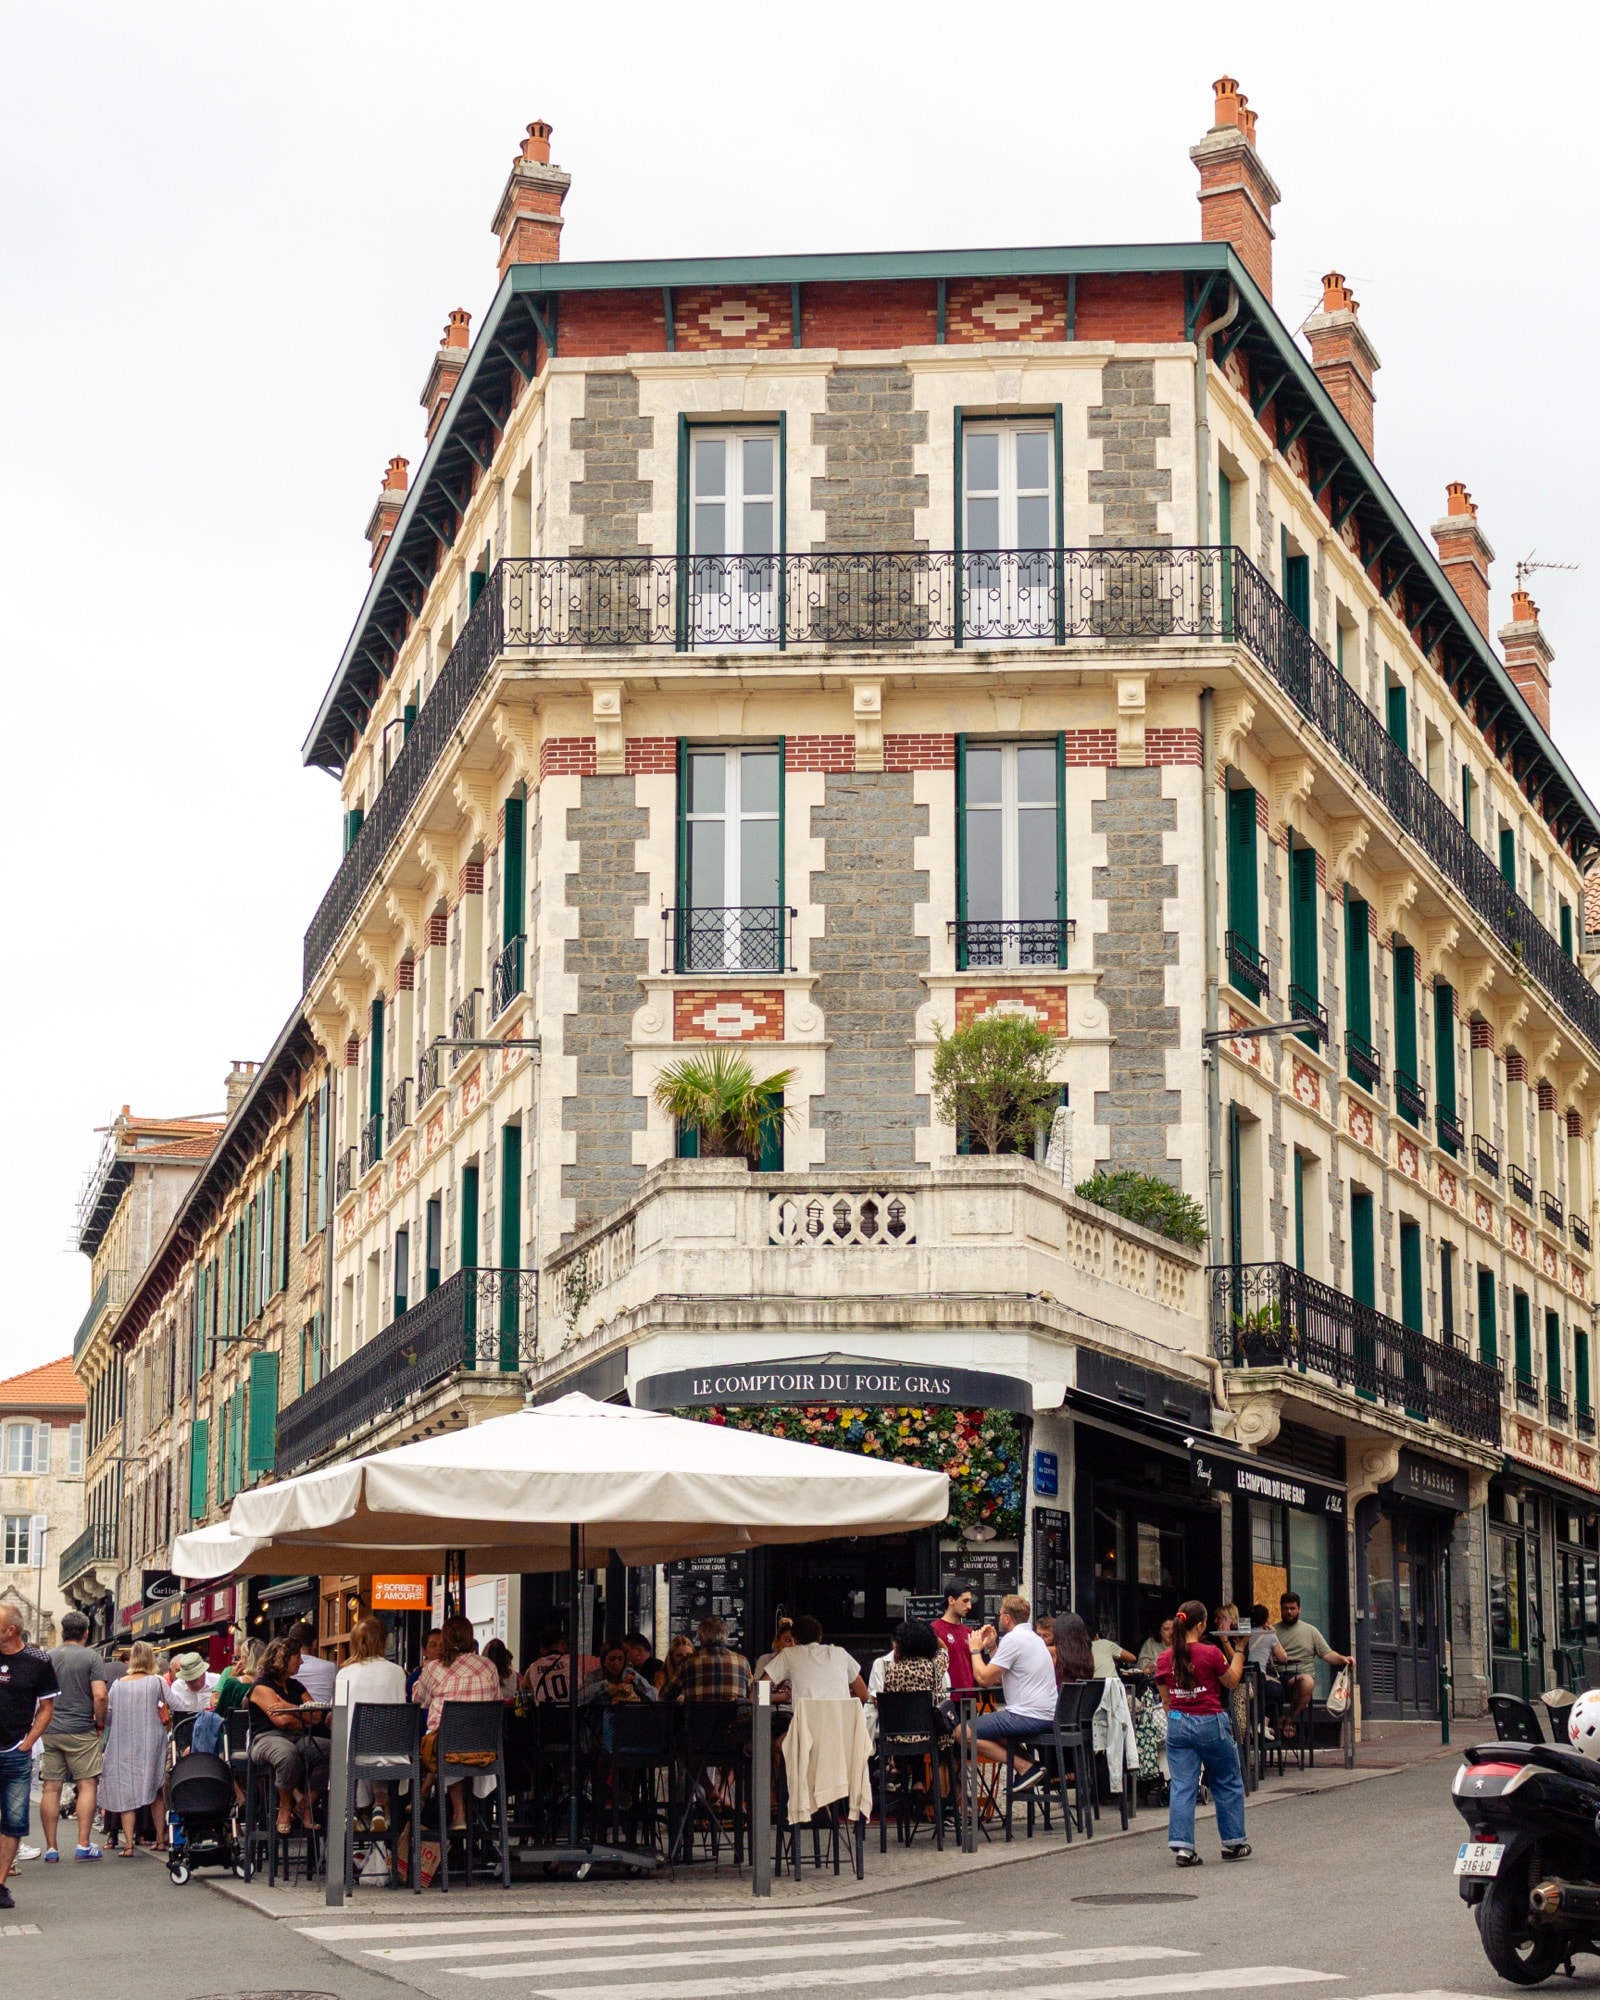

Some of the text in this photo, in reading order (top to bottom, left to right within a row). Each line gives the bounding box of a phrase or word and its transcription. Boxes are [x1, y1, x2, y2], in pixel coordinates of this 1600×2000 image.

[693, 1374, 950, 1395] LE COMPTOIR DU FOIE GRAS
[1237, 1470, 1246, 1489] LE
[1245, 1472, 1272, 1496] COMPTOIR
[1272, 1480, 1281, 1499] DU
[1281, 1483, 1292, 1502] FOIE
[1292, 1486, 1306, 1505] GRAS
[1411, 1466, 1454, 1493] LE PASSAGE
